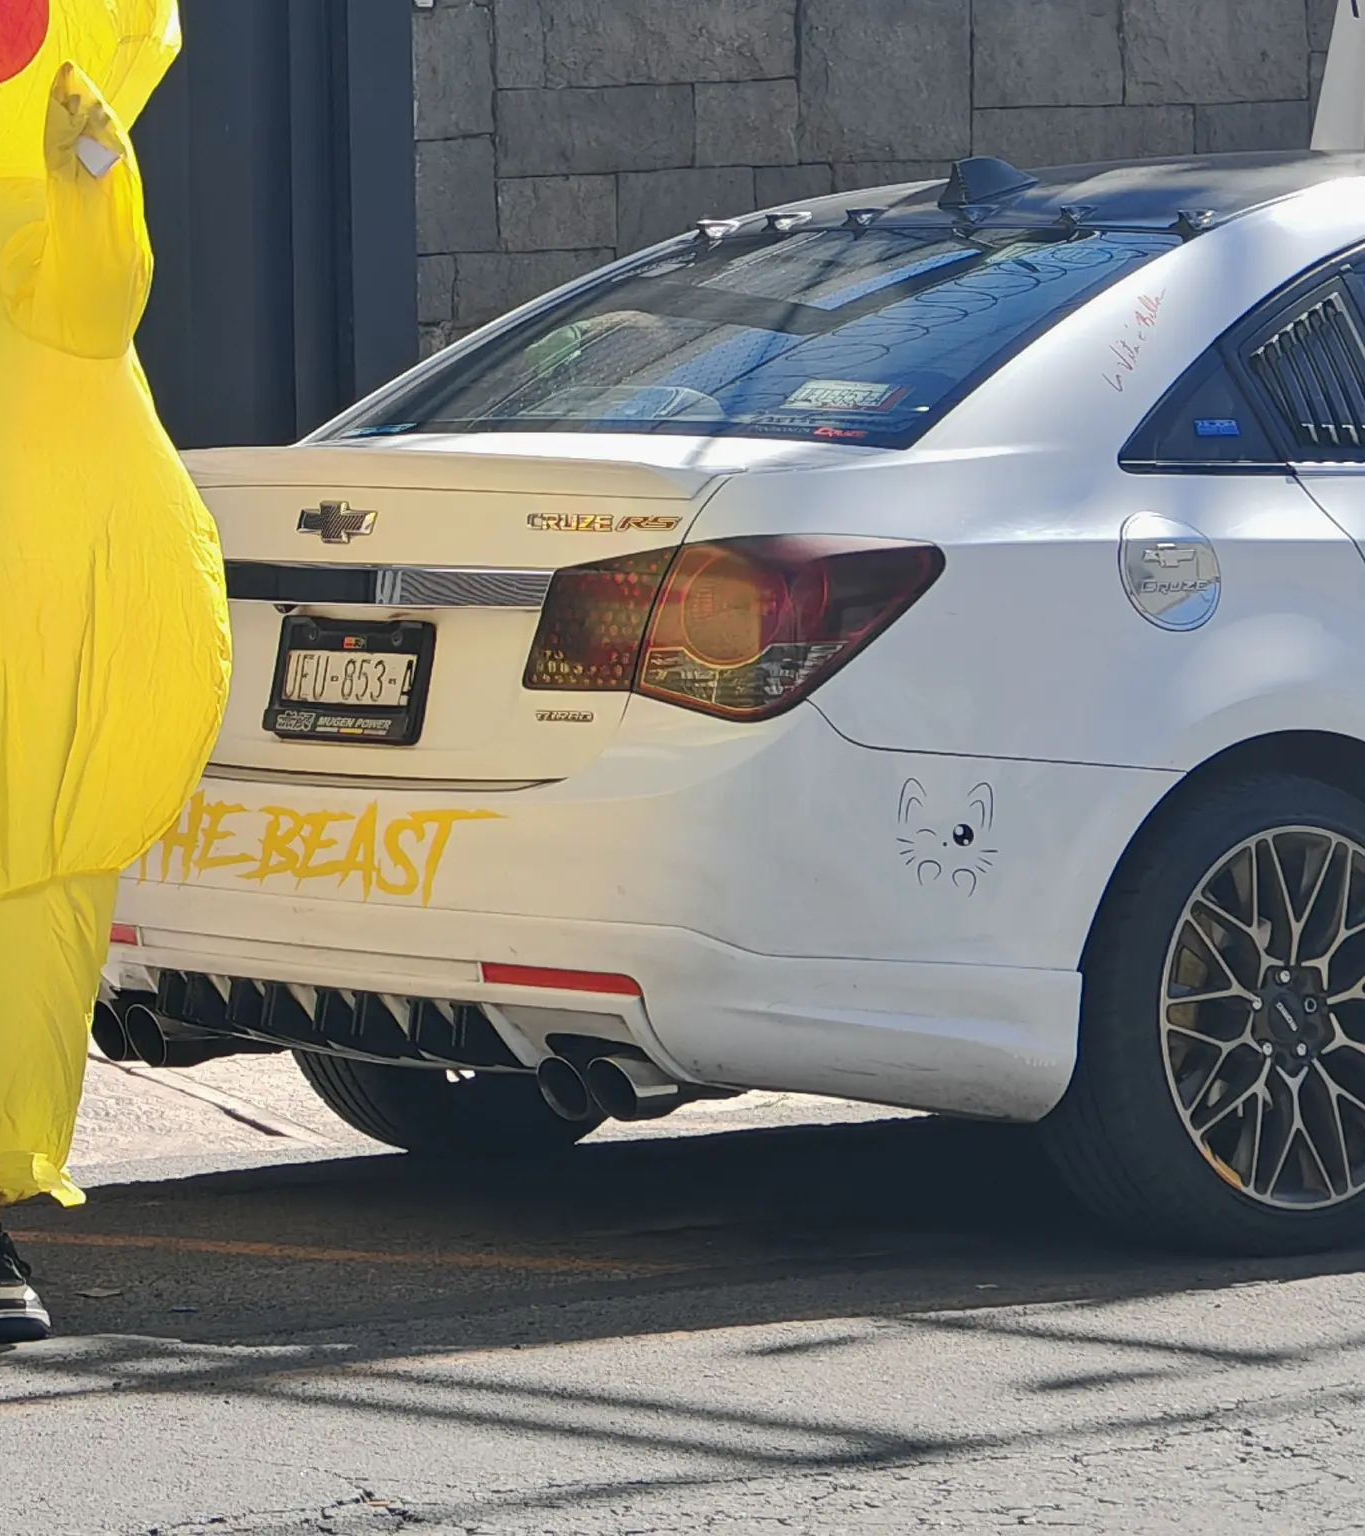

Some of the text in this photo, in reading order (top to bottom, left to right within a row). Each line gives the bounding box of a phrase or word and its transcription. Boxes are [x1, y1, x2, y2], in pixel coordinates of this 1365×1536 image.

[526, 512, 684, 532] CRUZE RS
[317, 715, 355, 728] MUGEN
[354, 717, 393, 730] POWER
[236, 797, 510, 909] BEAST
